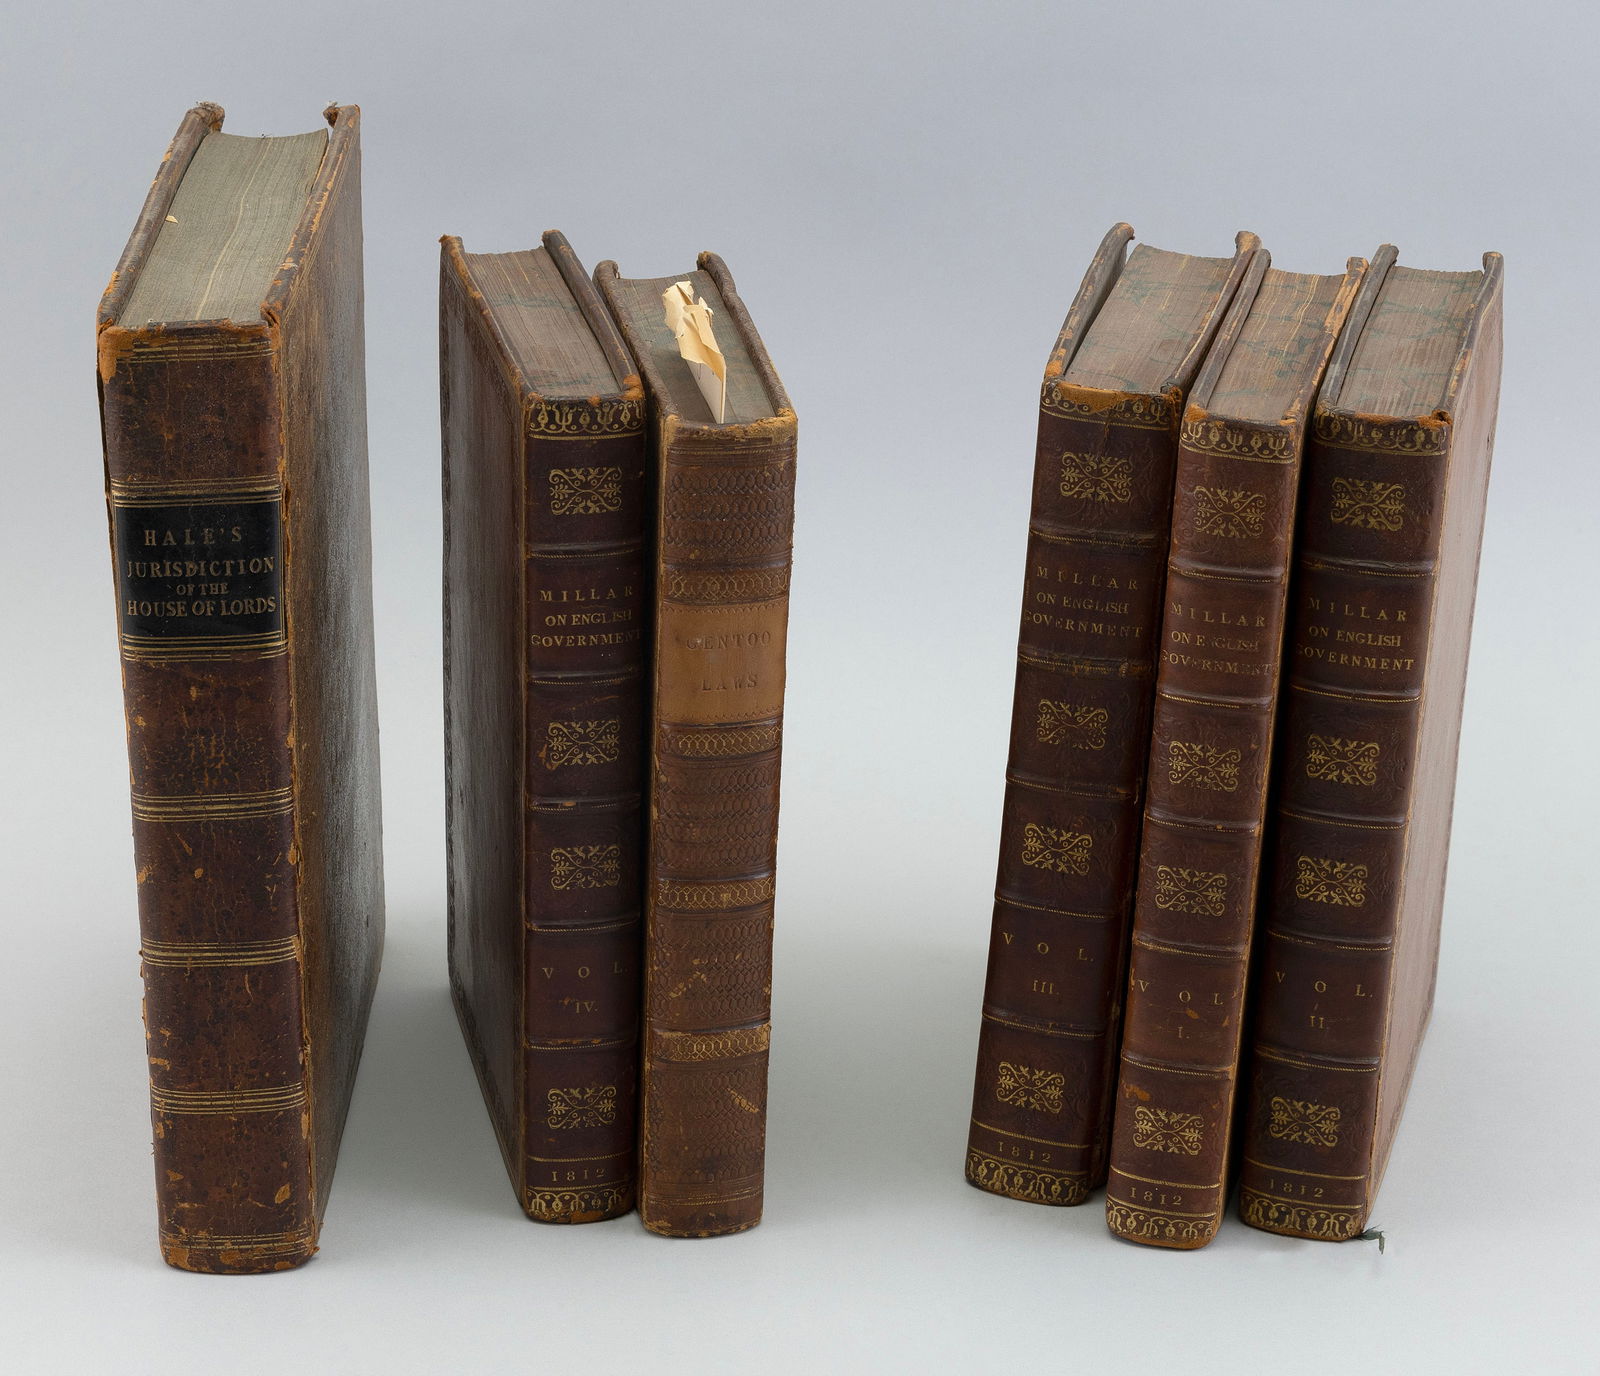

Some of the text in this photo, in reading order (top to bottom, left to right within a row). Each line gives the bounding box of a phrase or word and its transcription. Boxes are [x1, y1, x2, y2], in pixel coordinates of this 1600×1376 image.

[144, 526, 242, 546] HALE'S
[127, 557, 275, 578] JURISDICTION
[1036, 566, 1138, 591] MILLAR
[176, 583, 230, 596] OF THE
[540, 585, 633, 602] MILLAR
[127, 597, 277, 617] HOUSE OF LORDS
[1036, 592, 1129, 614] ON ENGLISH
[1309, 598, 1407, 621] MILLAR
[545, 609, 632, 627] ON ENGLISH
[1171, 602, 1266, 627] MILLAR
[686, 631, 772, 650] GENTOO
[1171, 631, 1191, 644] ON
[1309, 626, 1401, 647] ON ENGLISH
[702, 673, 758, 691] LAWS
[1003, 931, 1094, 962] VOL.
[1276, 971, 1374, 998] VOL.
[575, 1000, 599, 1014] IV.
[999, 1141, 1052, 1163] 1812
[551, 1167, 605, 1182] 1812
[1129, 1186, 1183, 1206] 1812
[1270, 1178, 1325, 1198] 1812
